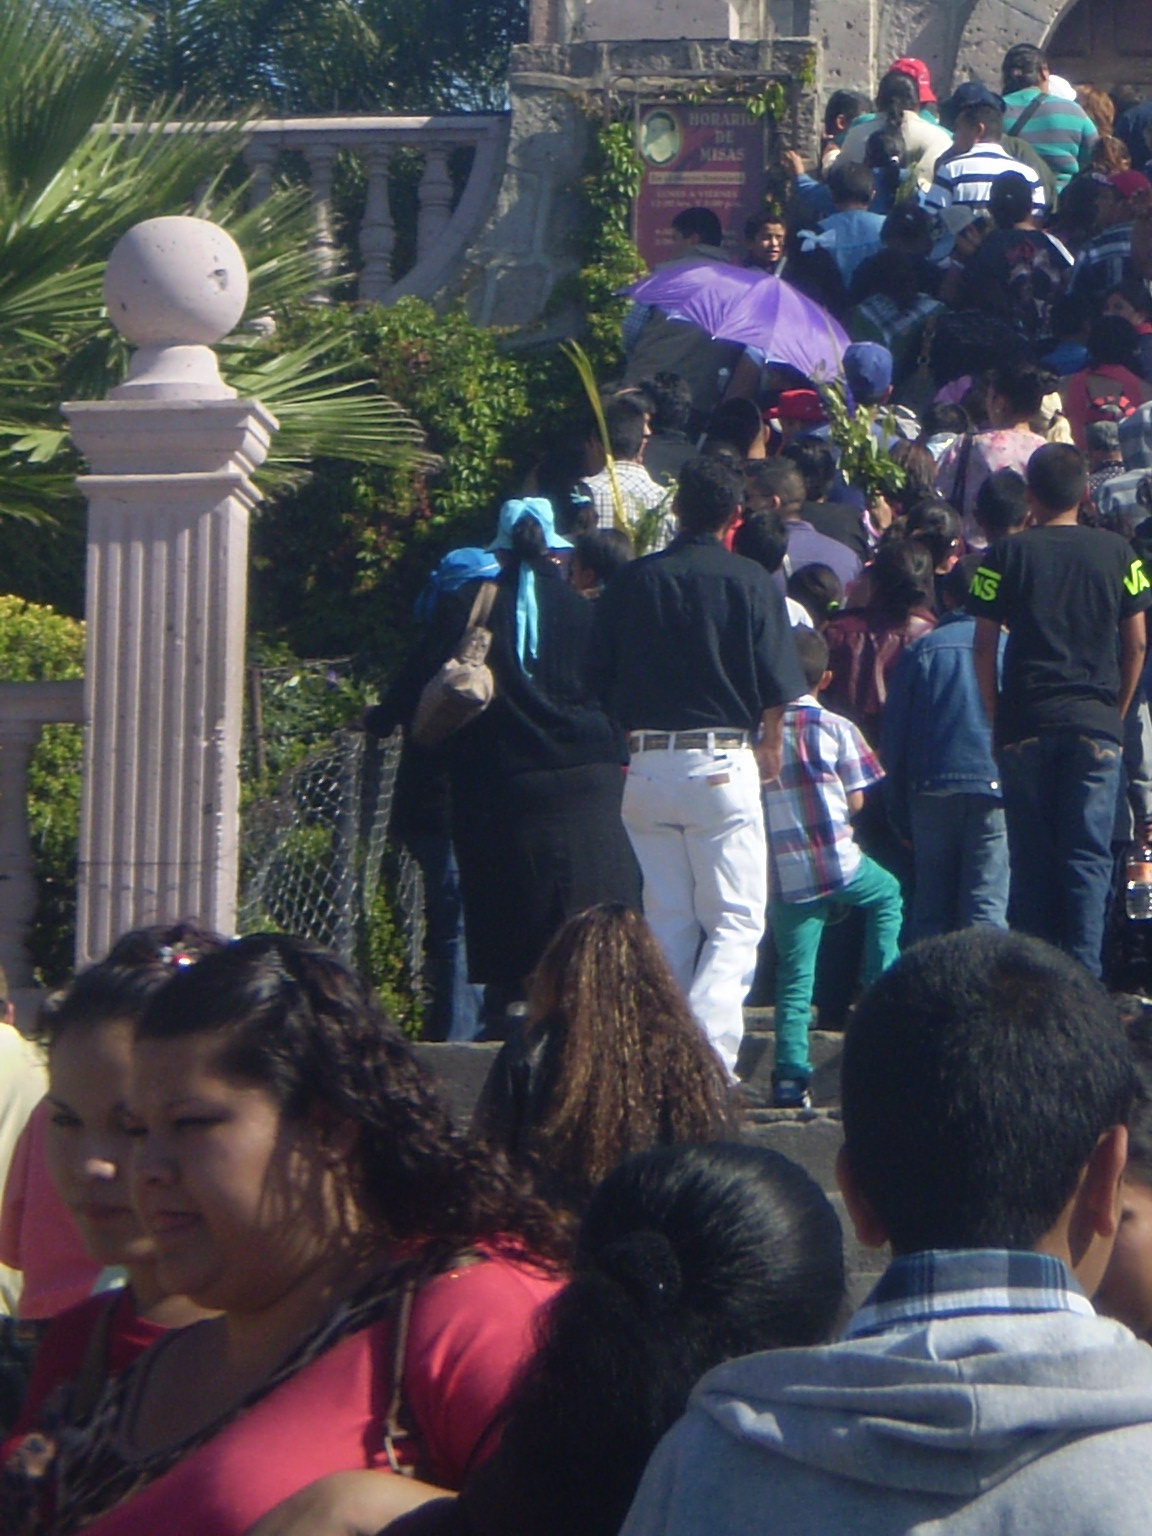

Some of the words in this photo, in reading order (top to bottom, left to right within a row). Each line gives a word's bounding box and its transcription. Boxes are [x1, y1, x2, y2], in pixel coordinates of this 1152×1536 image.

[689, 112, 757, 126] HORARIO
[715, 131, 734, 144] DE
[700, 148, 745, 162] MISAS
